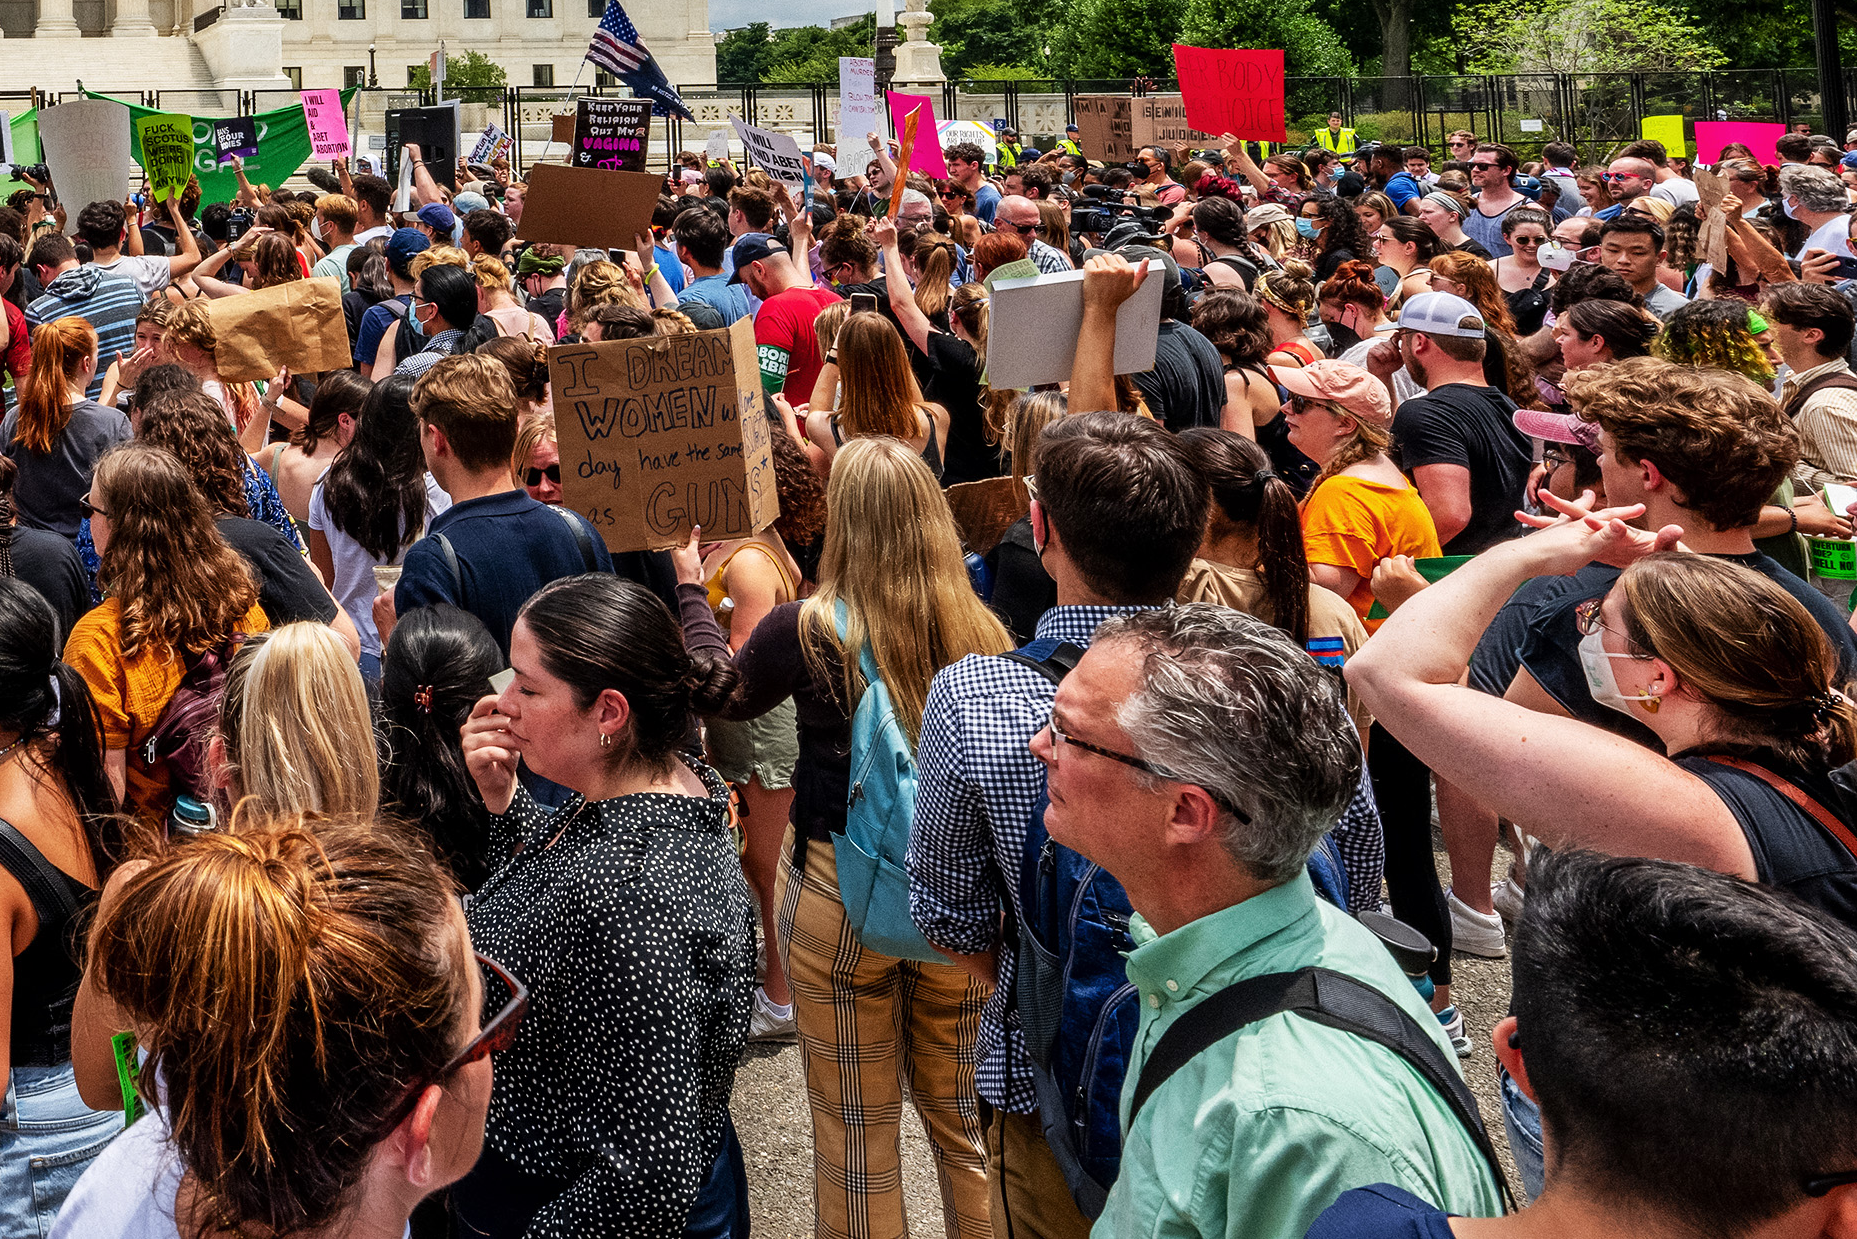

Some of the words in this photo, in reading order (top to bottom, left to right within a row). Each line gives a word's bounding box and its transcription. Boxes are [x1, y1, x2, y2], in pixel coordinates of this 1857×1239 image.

[1217, 58, 1280, 94] BODY
[308, 95, 325, 105] WILL
[307, 108, 319, 118] AID
[144, 123, 175, 135] FUCK
[310, 121, 316, 130] &
[146, 133, 190, 147] SCOTUS
[313, 132, 329, 142] ABET
[750, 130, 776, 151] WILL
[316, 142, 348, 154] ABORTION
[582, 137, 640, 151] VAGINA
[148, 146, 183, 157] WE'RE
[751, 146, 772, 163] AND
[771, 151, 803, 170] ABET
[150, 155, 185, 168] DOING
[153, 168, 162, 179] IT
[557, 351, 600, 398] I
[626, 336, 737, 392] DREAM
[574, 385, 717, 441] WOMEN
[577, 450, 621, 490] day
[637, 446, 682, 471] have
[684, 442, 711, 463] the
[715, 443, 744, 460] same
[587, 506, 616, 526] as
